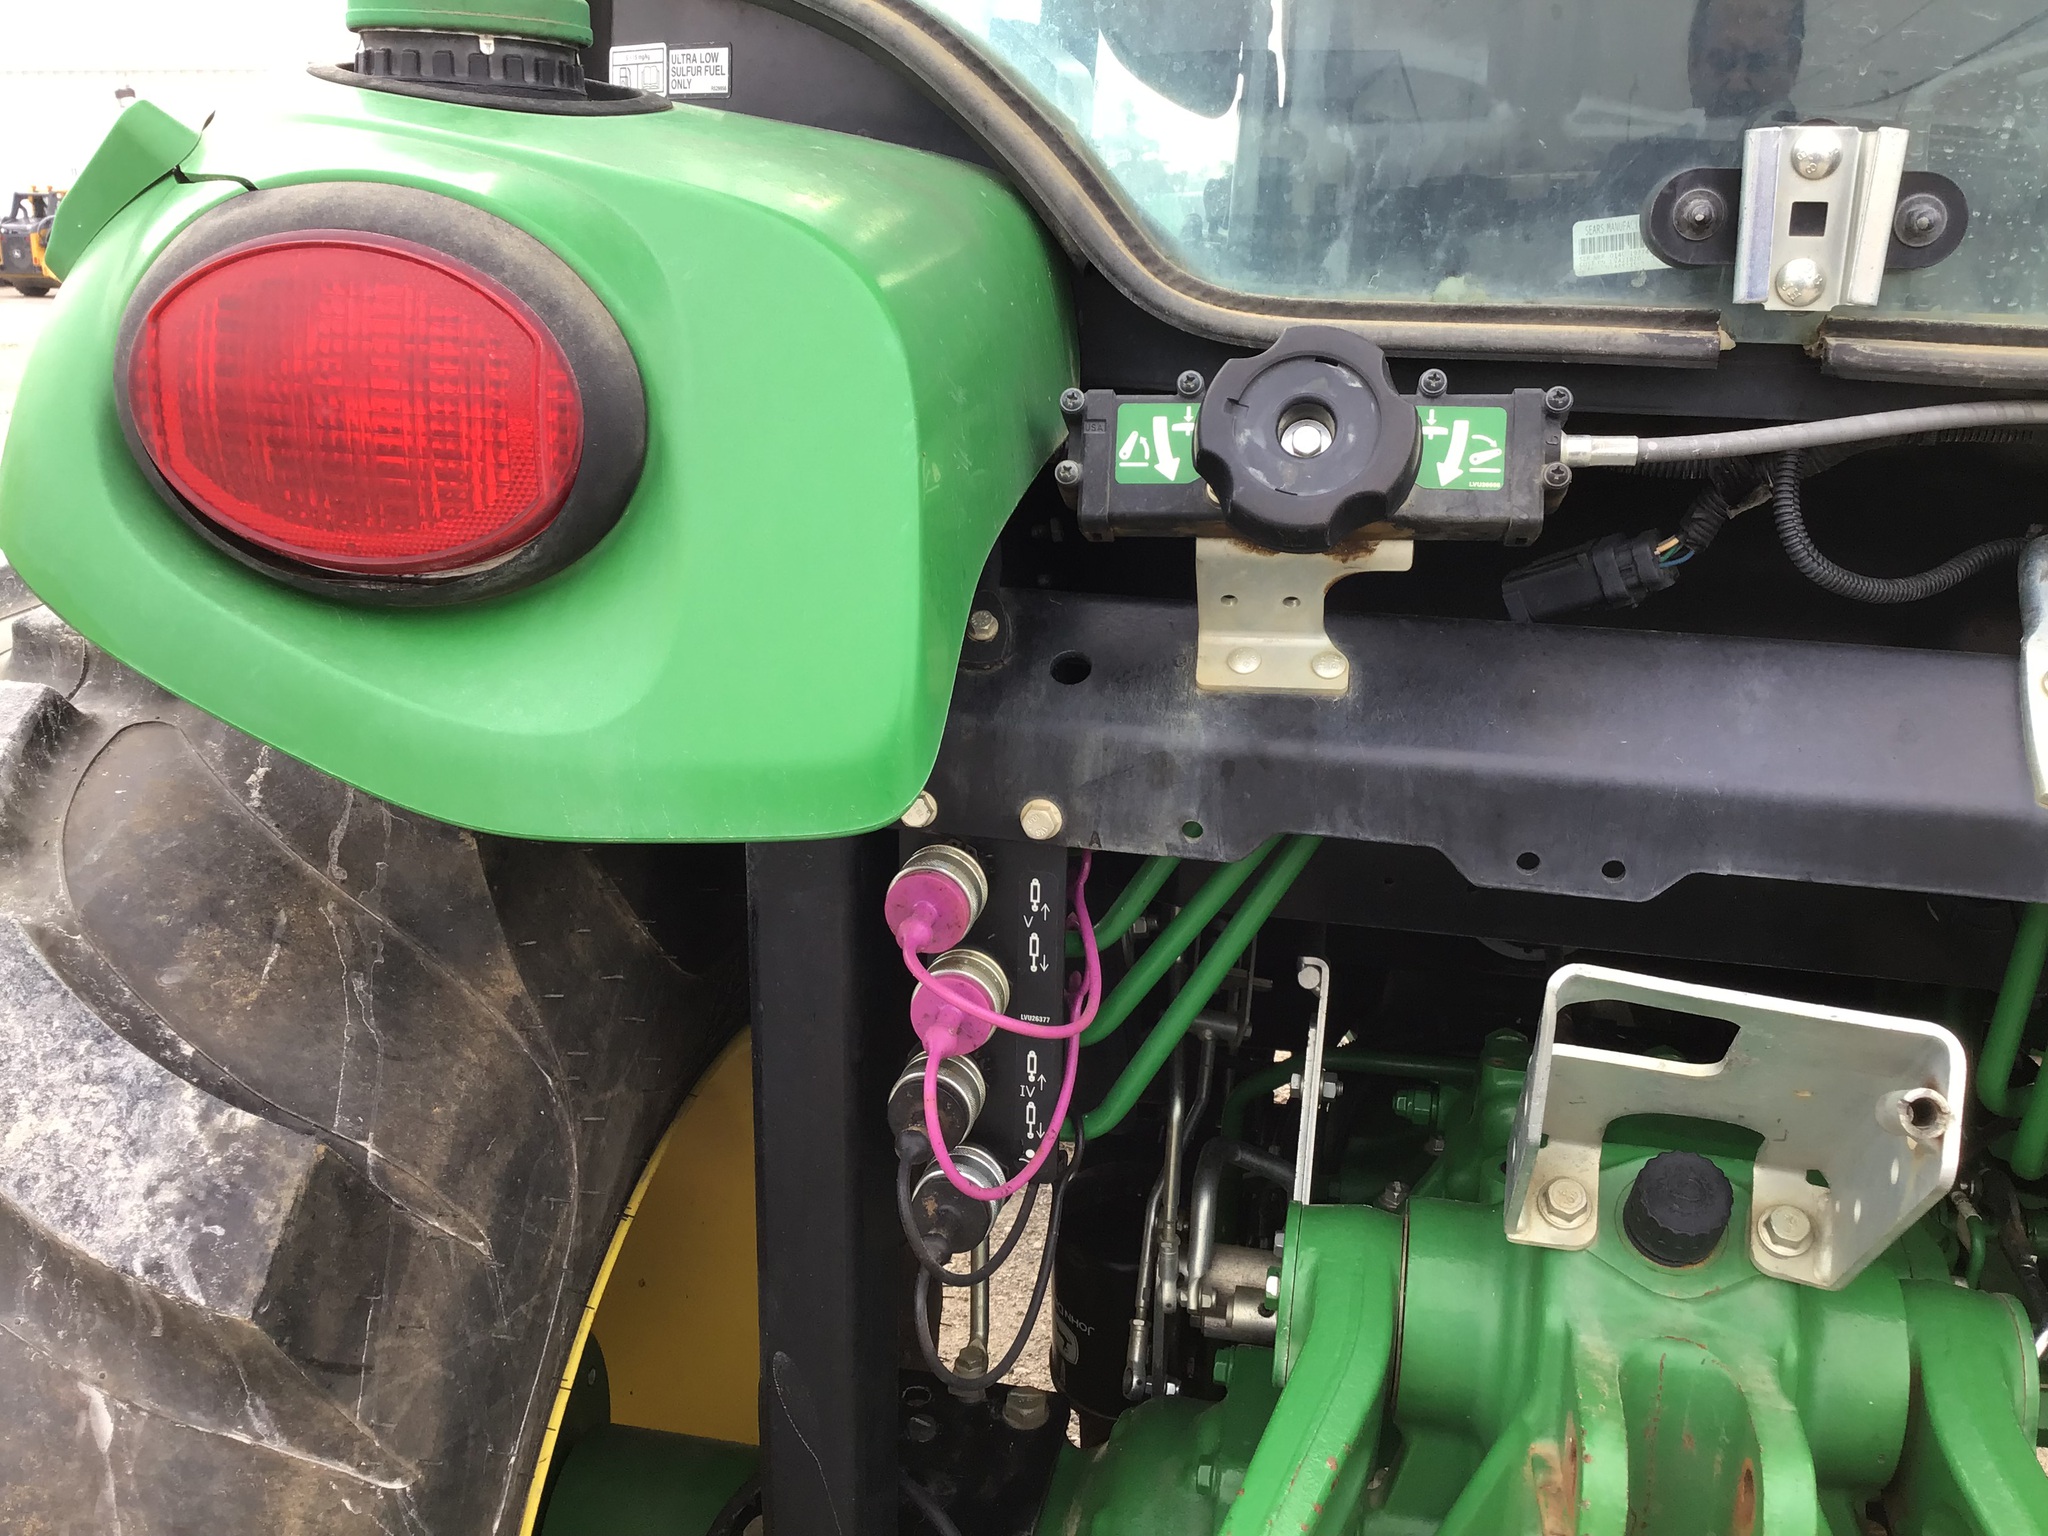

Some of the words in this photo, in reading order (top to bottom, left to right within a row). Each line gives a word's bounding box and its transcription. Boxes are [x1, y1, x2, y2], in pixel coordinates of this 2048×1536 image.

[671, 53, 698, 64] ULTRA
[700, 52, 720, 64] LOW
[671, 65, 703, 77] SULFUR
[704, 65, 726, 76] FUEL
[671, 79, 692, 90] ONLY
[1585, 223, 1605, 236] SEARS
[1085, 423, 1104, 432] USA
[1023, 915, 1034, 928] V
[1020, 1013, 1051, 1024] LVU26377
[1019, 1085, 1036, 1098] IV
